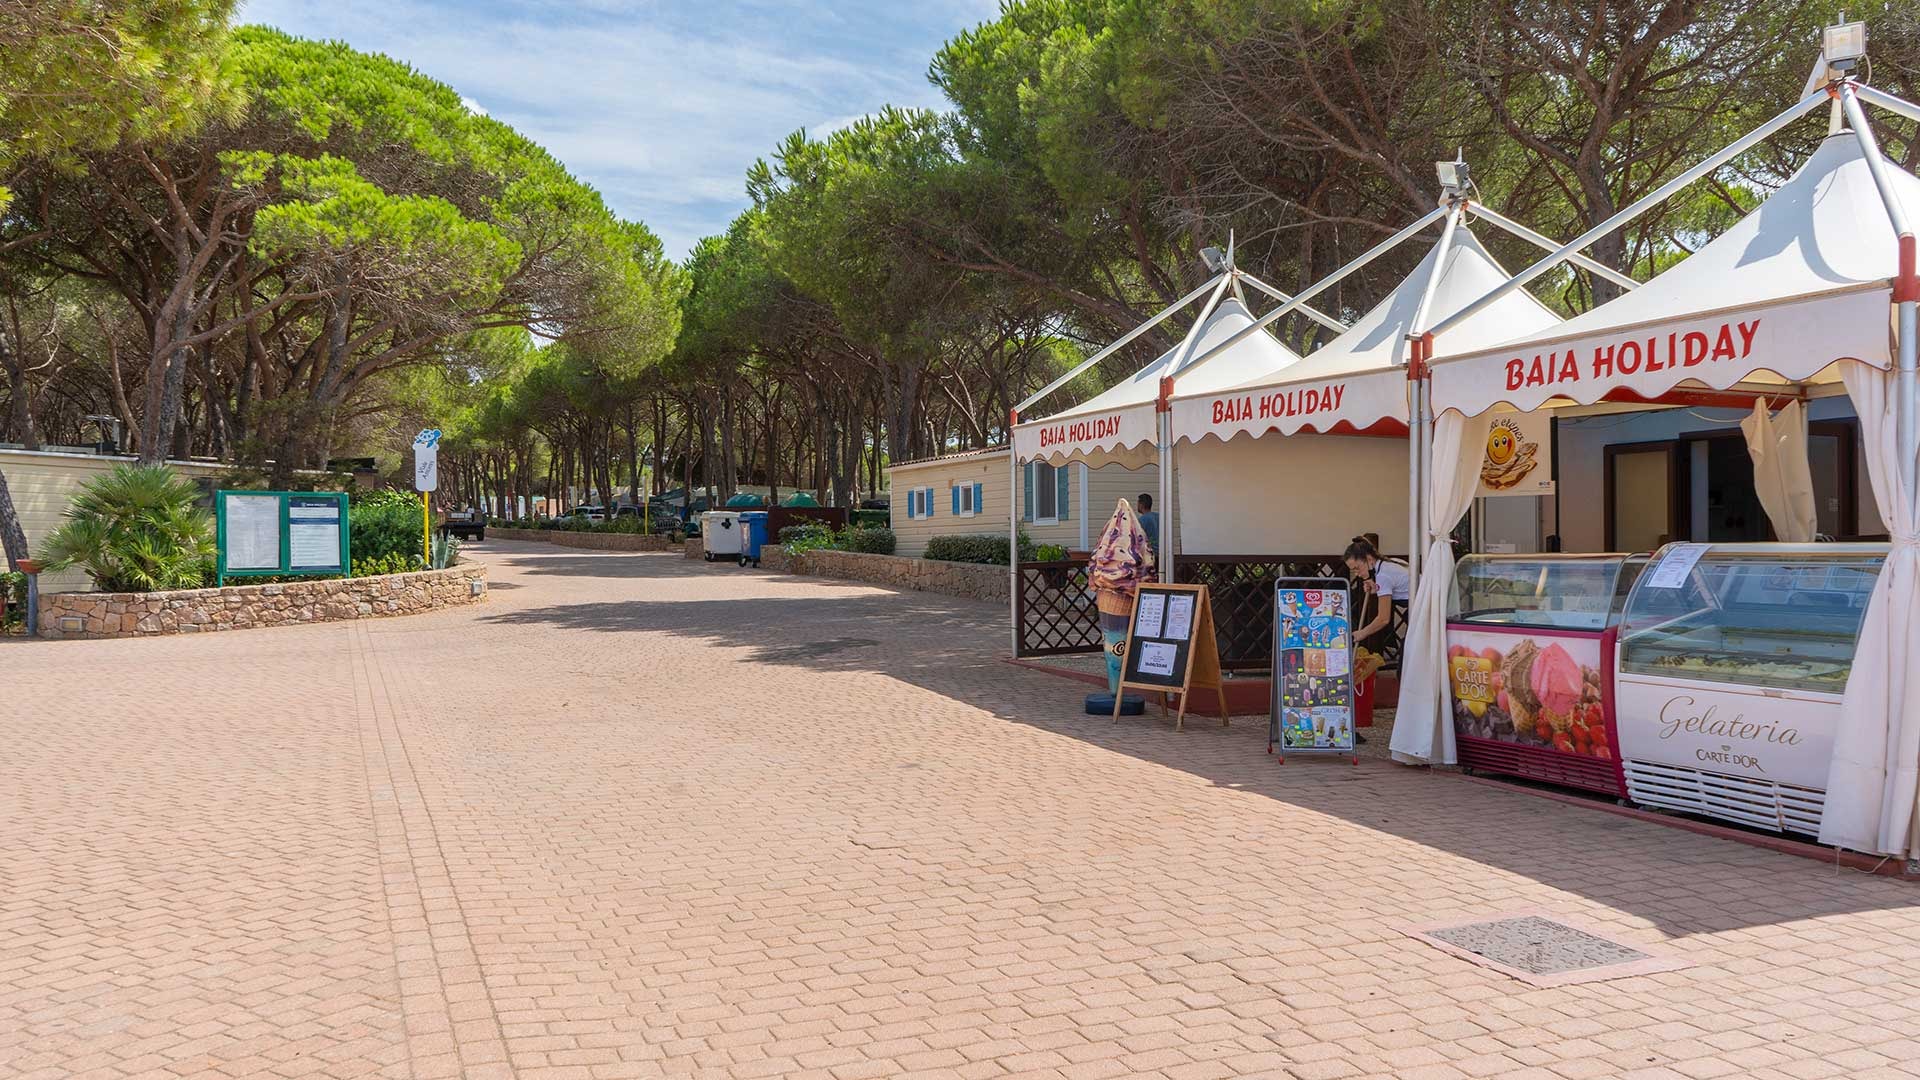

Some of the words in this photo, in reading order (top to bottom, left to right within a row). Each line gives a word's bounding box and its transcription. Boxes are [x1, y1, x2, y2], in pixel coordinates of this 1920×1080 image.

[1505, 350, 1580, 391] BAIA
[1592, 319, 1761, 378] HOLIDAY
[1212, 396, 1252, 425] BAIA
[1259, 384, 1345, 419] HOLIDAY
[1040, 427, 1066, 448] BAIA
[1069, 416, 1121, 442] HOLIDAY
[1456, 667, 1489, 686] CARTE
[1461, 683, 1489, 699] D'OR
[1658, 695, 1803, 746] Gelateria
[1696, 748, 1731, 764] CARTE
[1733, 754, 1767, 774] D'OR
